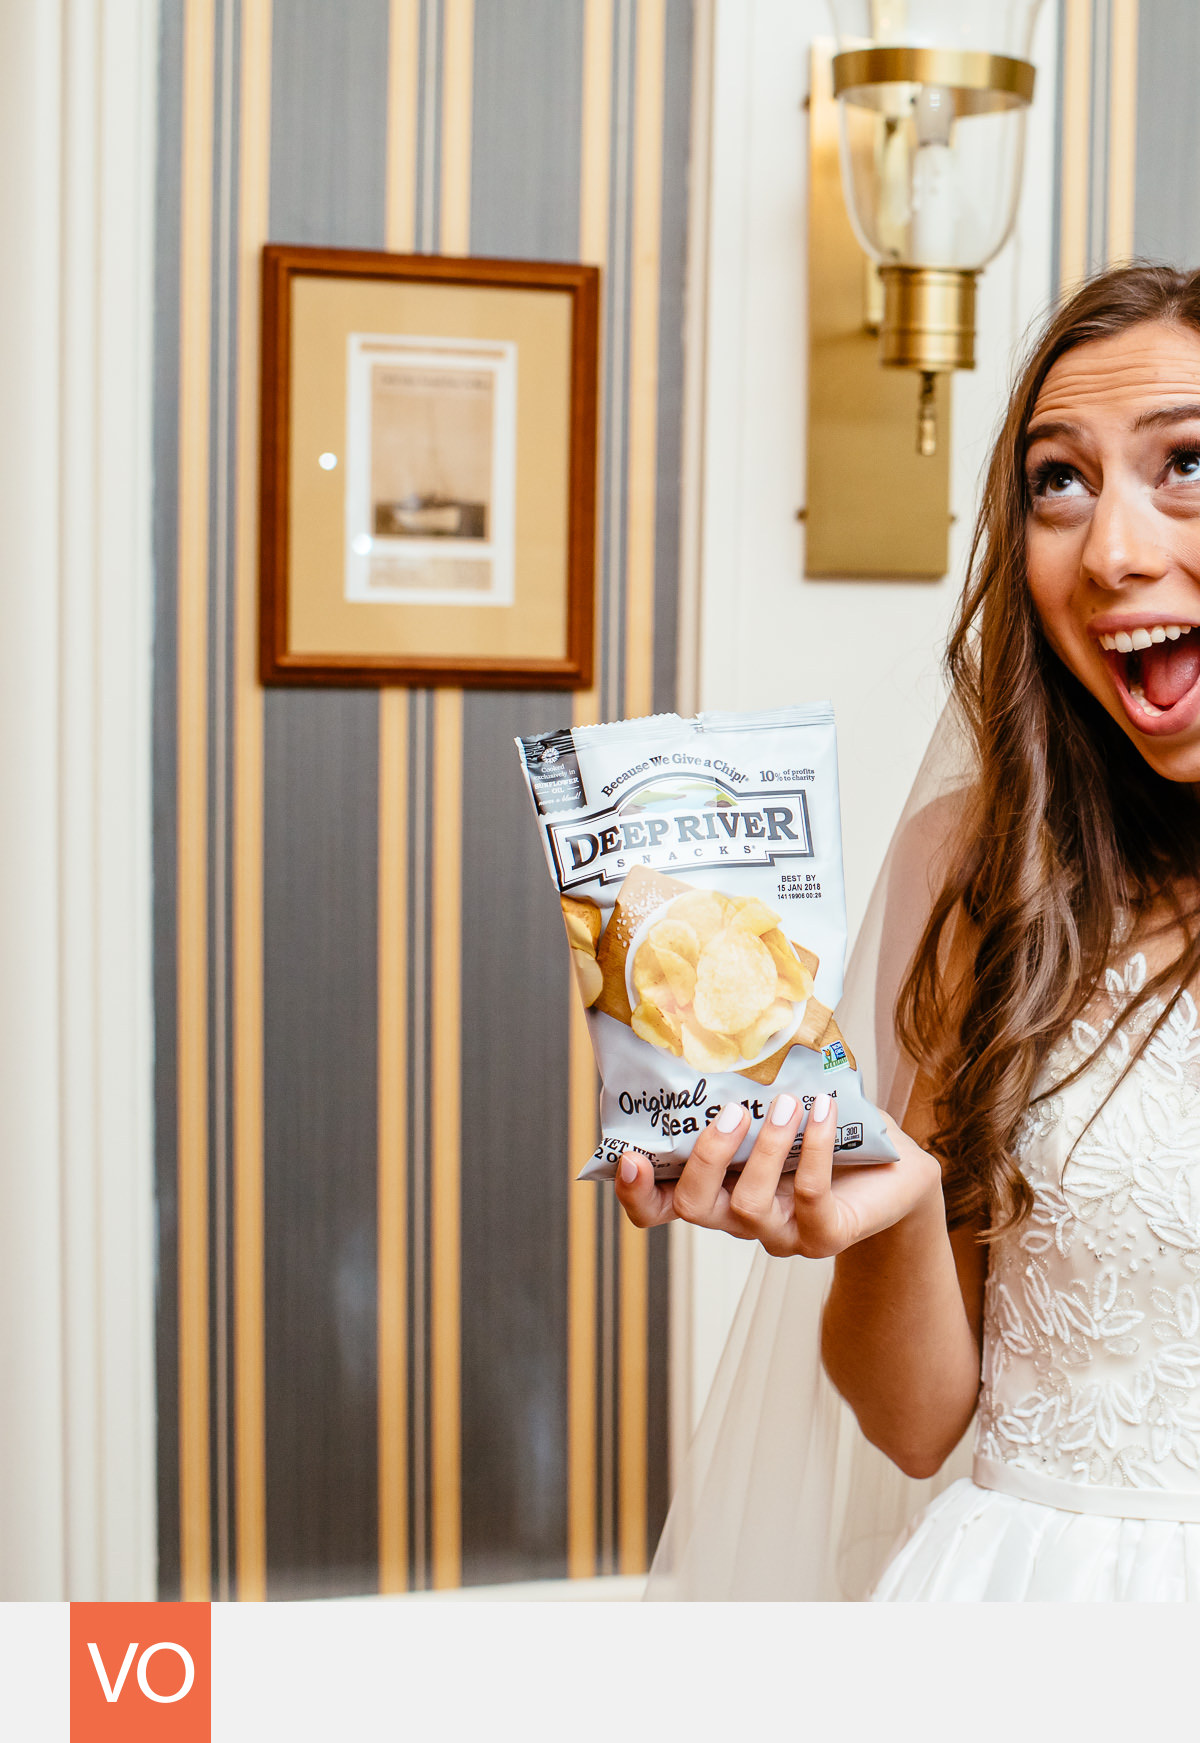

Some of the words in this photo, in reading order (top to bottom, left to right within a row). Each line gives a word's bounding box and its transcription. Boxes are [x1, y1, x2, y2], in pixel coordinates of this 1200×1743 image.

[541, 763, 565, 773] Cooked
[791, 768, 815, 776] profits
[601, 761, 650, 797] Because
[649, 755, 670, 767] We
[672, 753, 701, 766] Give
[703, 758, 712, 768] a
[713, 759, 747, 784] Chip!
[534, 777, 579, 789] SUNFLOWER
[565, 818, 670, 870] DEEP
[674, 807, 799, 843] RIVER
[617, 845, 752, 868] SNACKS
[781, 874, 801, 882] BEST
[805, 874, 816, 882] BY
[787, 883, 802, 891] JAN
[618, 1078, 708, 1127] Original
[802, 1090, 837, 1103] Cod
[662, 1113, 699, 1136] Sea
[705, 1099, 764, 1127] St
[846, 1126, 858, 1136] 300
[594, 1146, 604, 1160] 2
